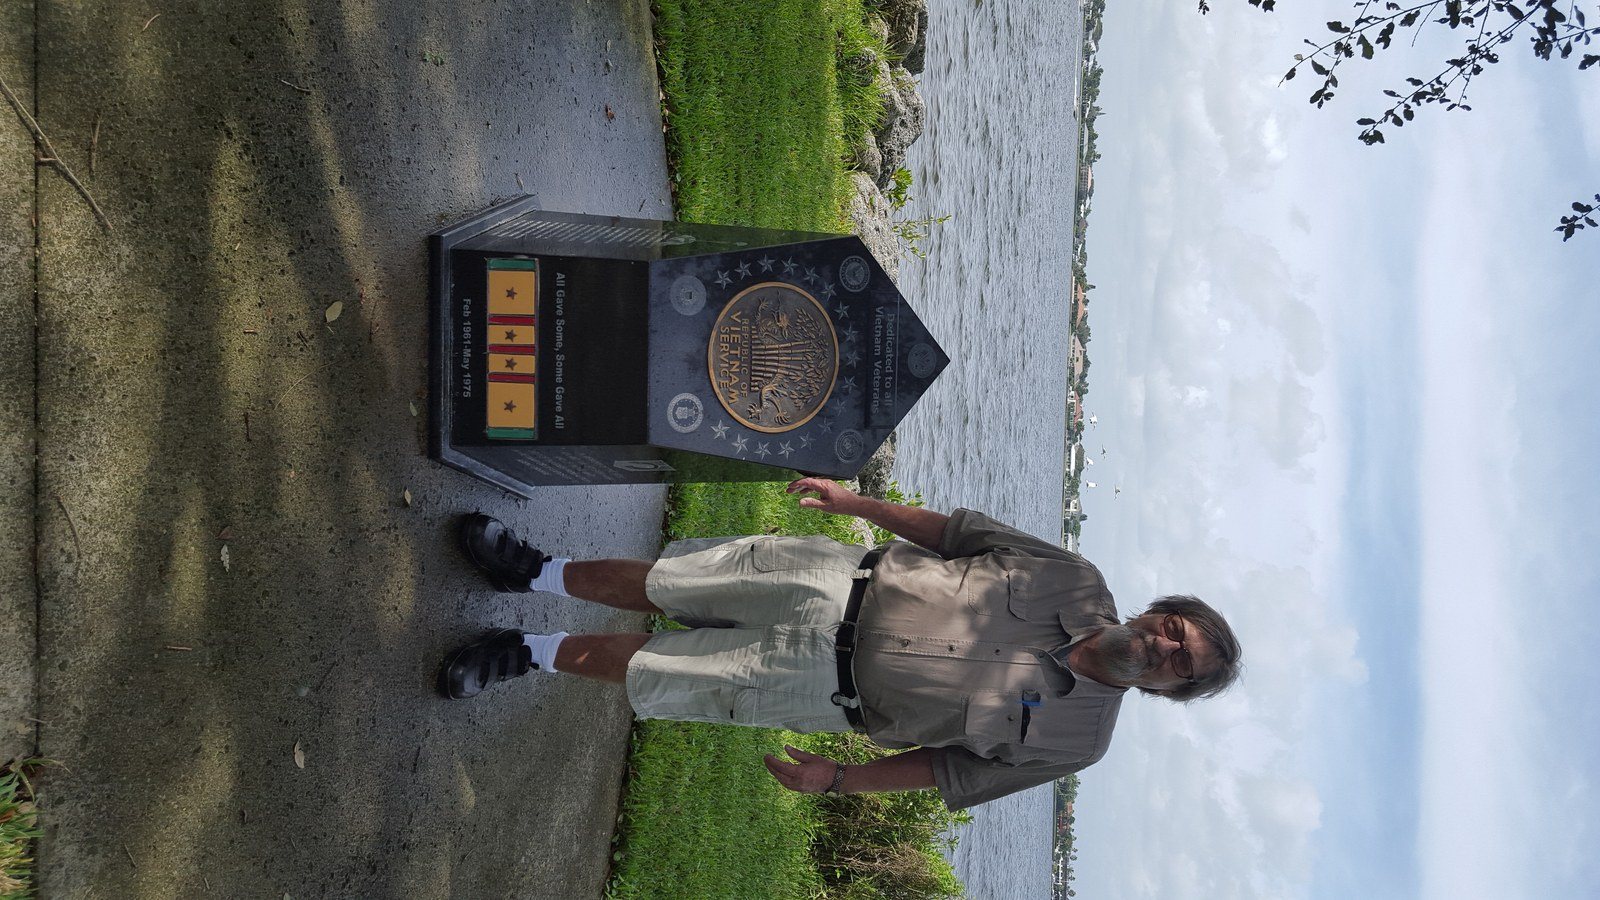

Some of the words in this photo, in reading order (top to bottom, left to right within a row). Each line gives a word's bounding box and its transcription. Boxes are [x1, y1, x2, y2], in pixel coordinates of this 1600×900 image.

[555, 272, 566, 287] All
[462, 298, 471, 317] Feb
[555, 289, 565, 316] Gave
[553, 318, 565, 351] Some,
[873, 305, 884, 356] Vietnam
[884, 313, 895, 374] Dedicated
[460, 320, 471, 370] 1961-May
[719, 326, 730, 389] SERVICE
[728, 311, 740, 404] VIETNAM
[740, 318, 750, 376] REPUBLIC
[555, 354, 565, 384] Some
[884, 376, 894, 389] to
[462, 372, 471, 398] 1975
[739, 382, 749, 397] OF
[871, 360, 882, 414] Veterans
[883, 391, 894, 407] all
[555, 386, 564, 413] Gave
[554, 415, 564, 429] All
